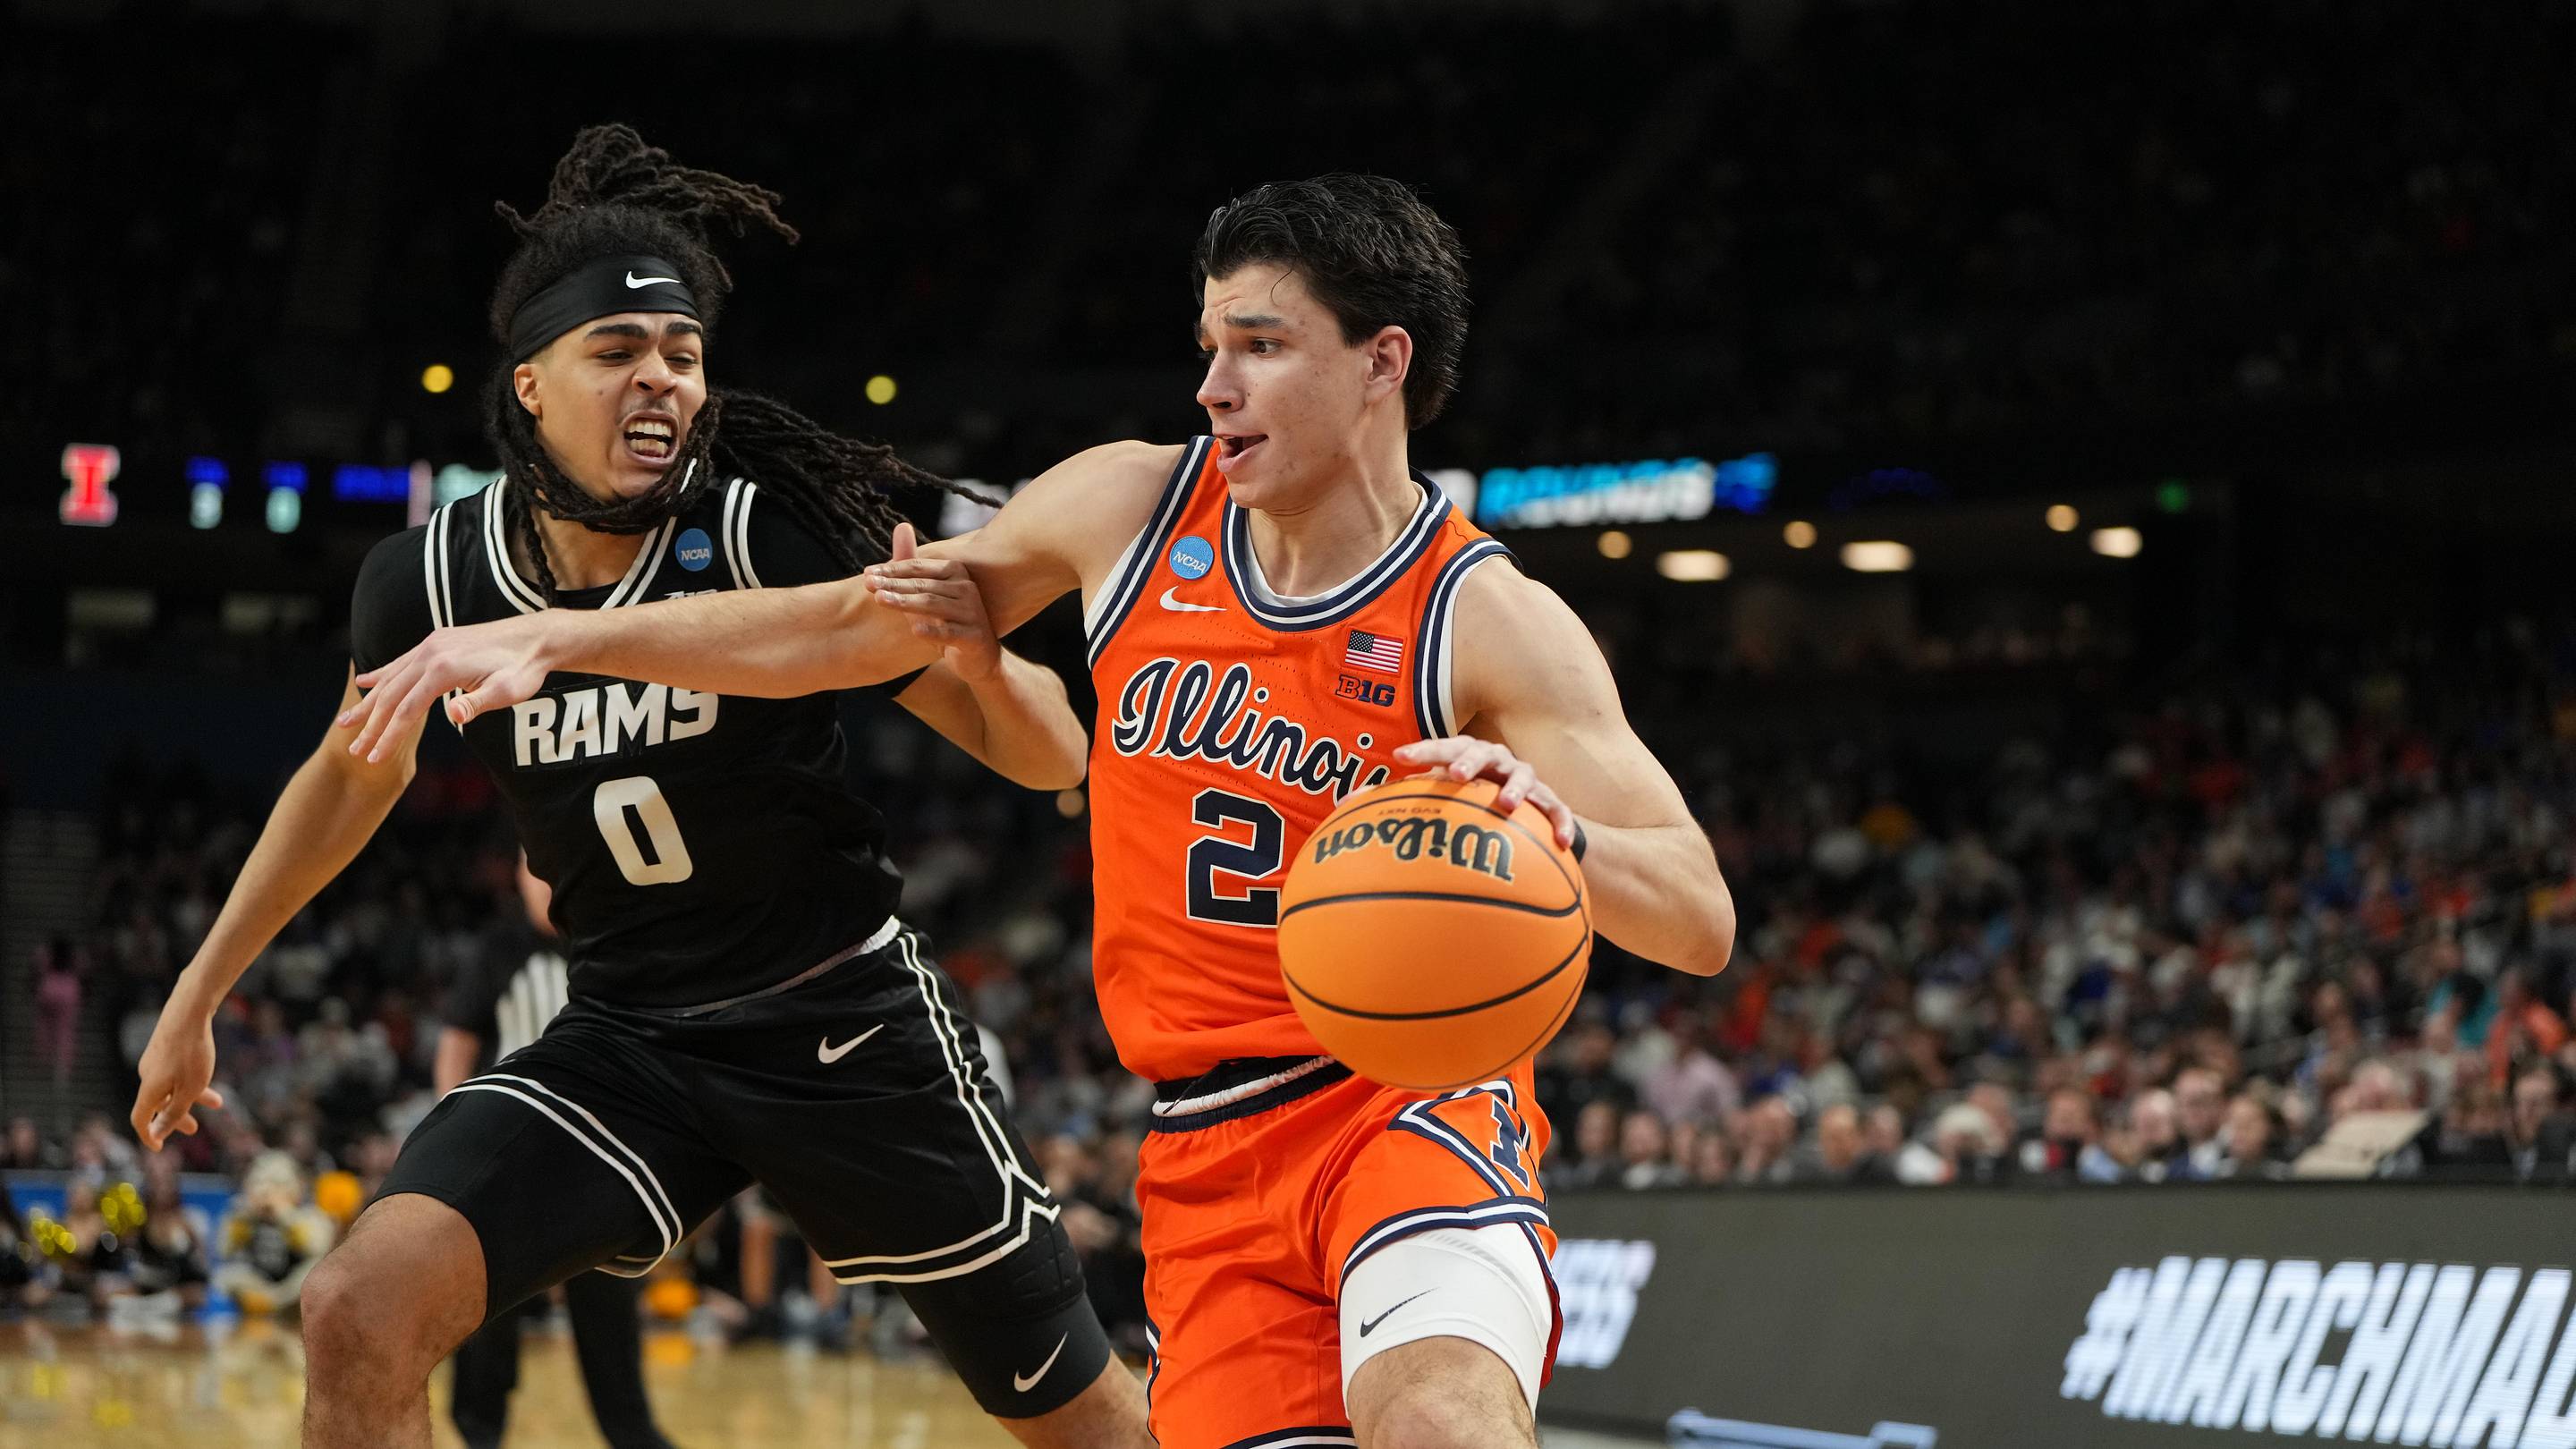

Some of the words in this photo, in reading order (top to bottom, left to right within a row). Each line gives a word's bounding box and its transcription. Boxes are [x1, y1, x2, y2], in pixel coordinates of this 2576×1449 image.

[681, 548, 710, 562] NCAA
[1173, 551, 1208, 573] NCAA
[512, 682, 718, 766] RAMS
[593, 775, 693, 886] 0
[1186, 786, 1284, 928] 2
[1314, 816, 1515, 883] Wilson
